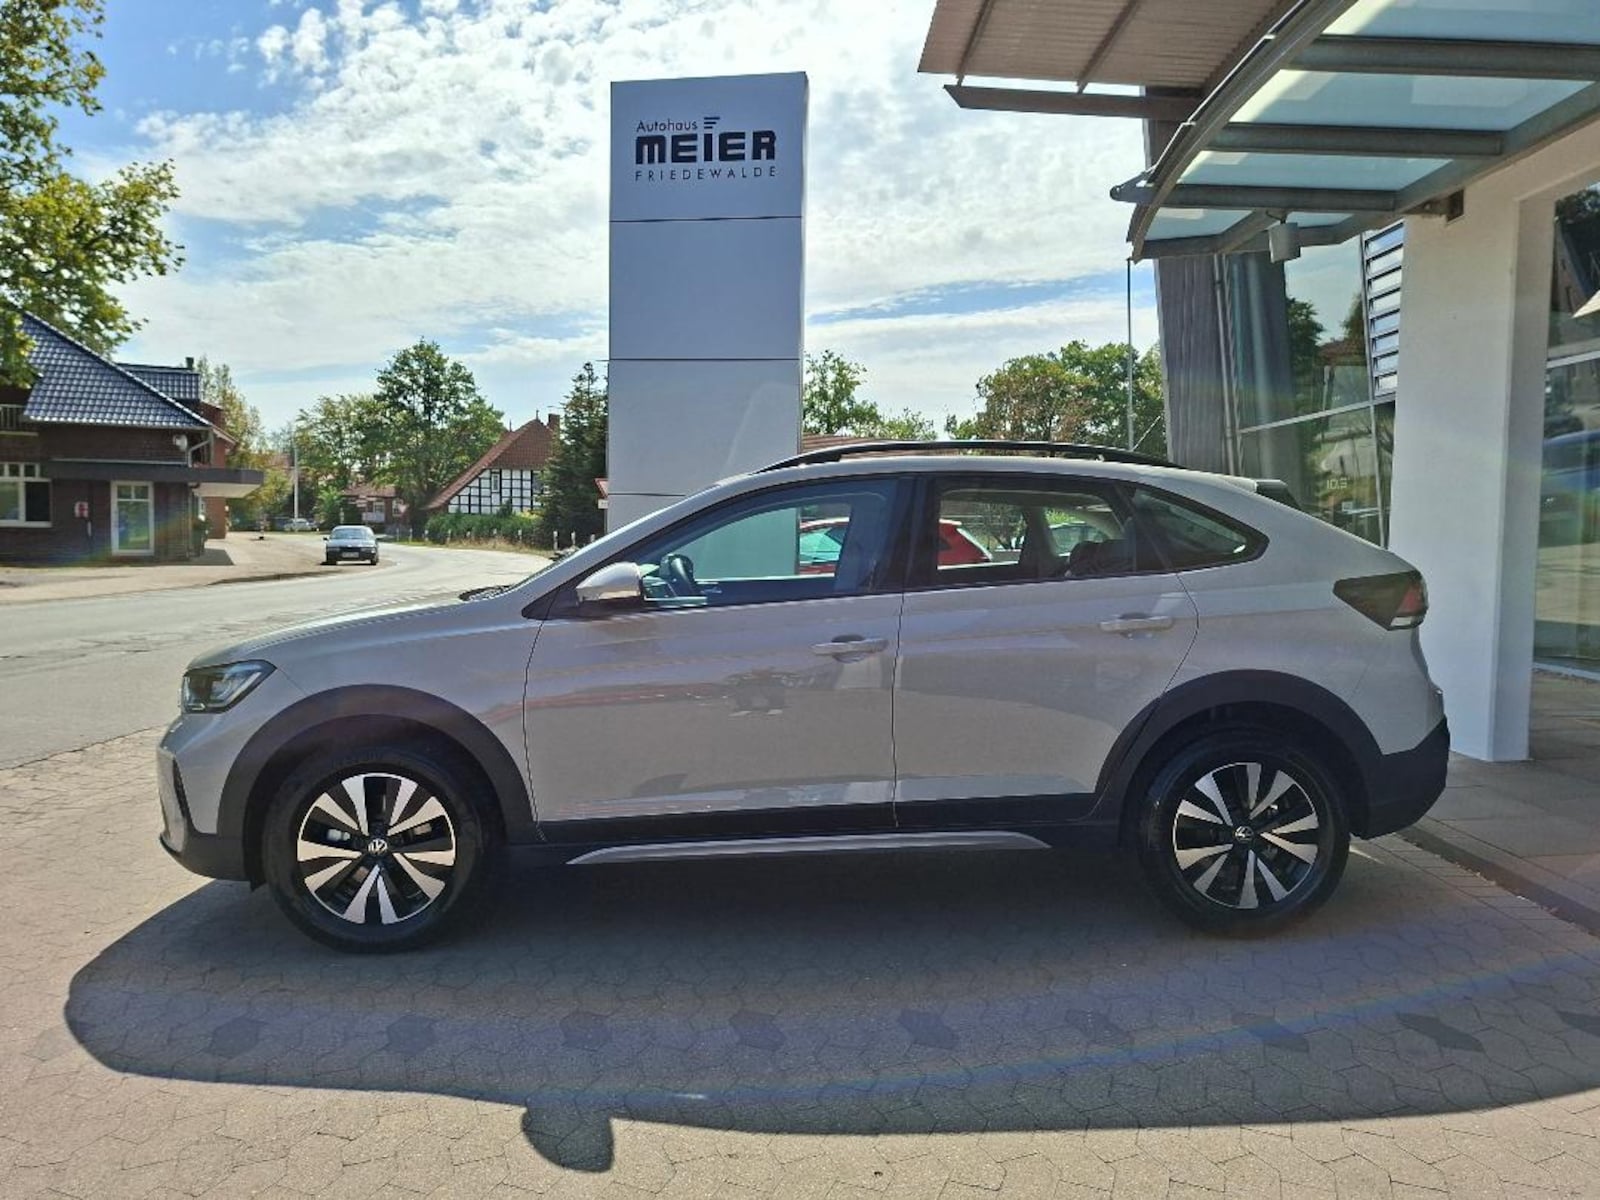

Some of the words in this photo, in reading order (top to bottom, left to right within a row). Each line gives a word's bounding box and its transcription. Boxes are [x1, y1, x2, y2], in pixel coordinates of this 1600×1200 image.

[636, 118, 698, 132] Autohaus
[635, 130, 776, 165] MEIER
[635, 166, 777, 182] FRIEDEWALDE
